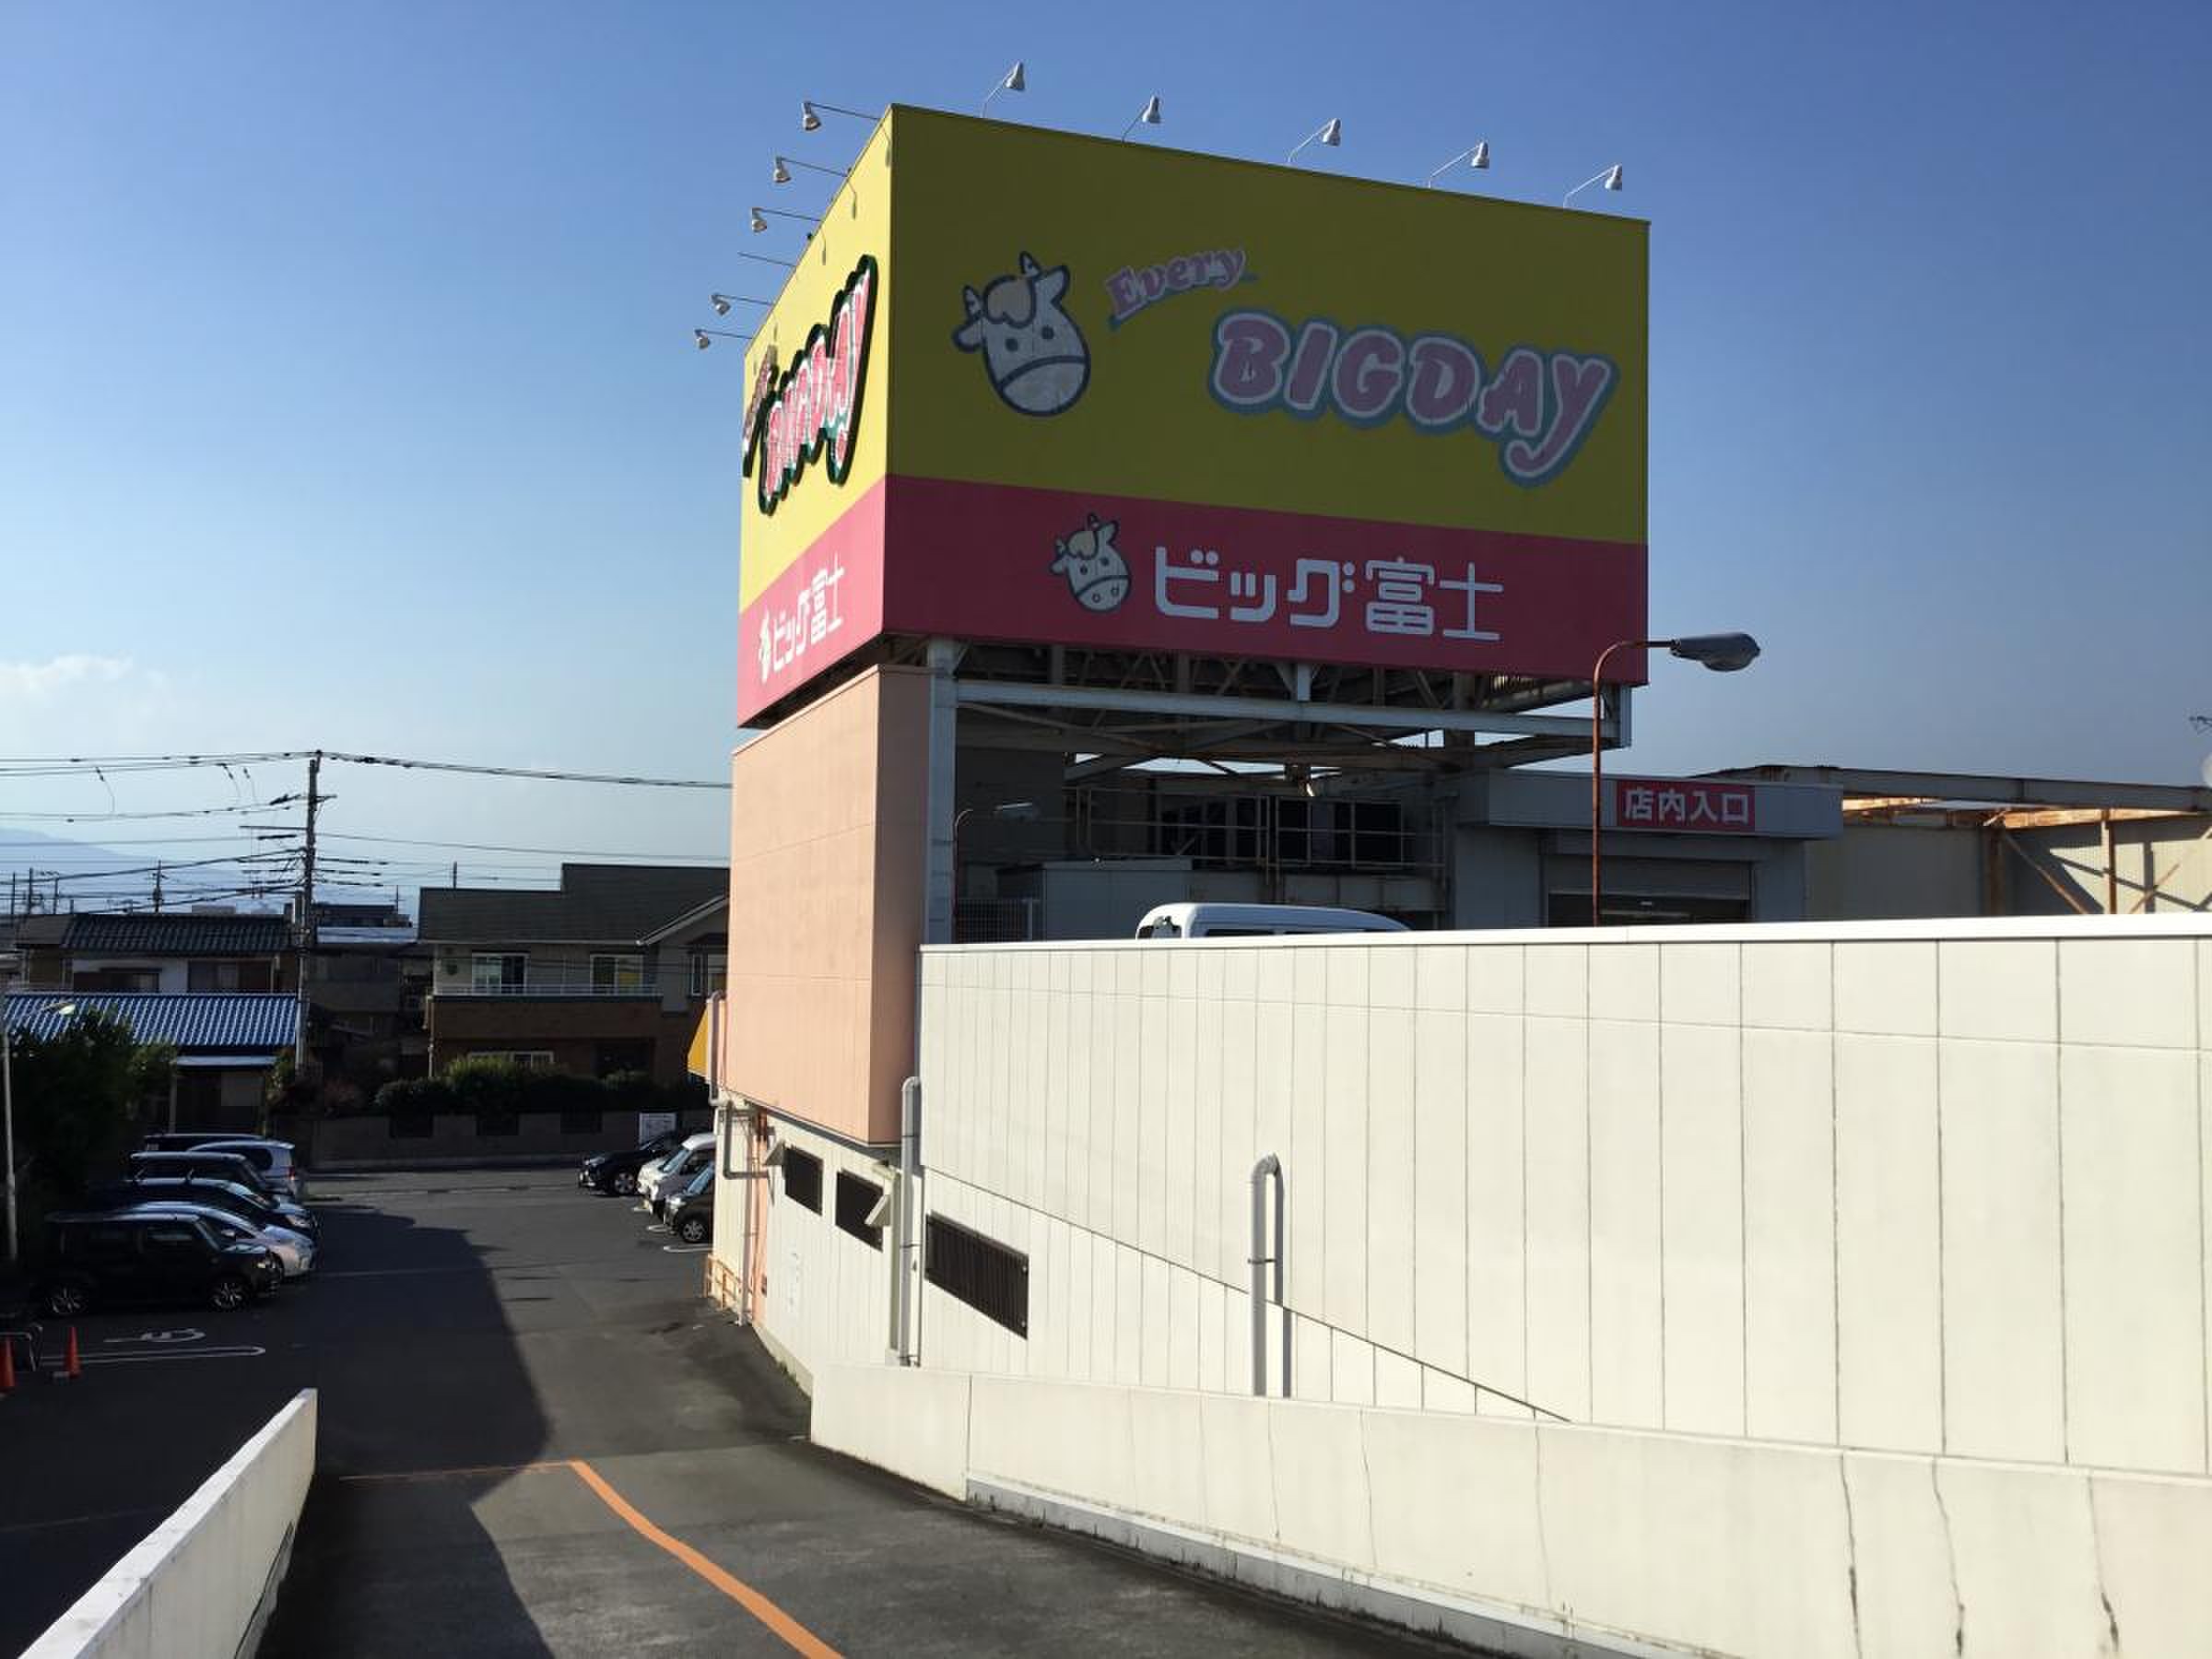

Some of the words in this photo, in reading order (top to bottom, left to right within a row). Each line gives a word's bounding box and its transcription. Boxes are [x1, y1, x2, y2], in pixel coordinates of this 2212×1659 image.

[1107, 248, 1249, 324] Every
[1209, 311, 1617, 485] BIGDAY
[772, 552, 845, 672] ビッグ富士
[1155, 547, 1503, 642] ビッグ富士
[1625, 787, 1749, 824] 店内入口
